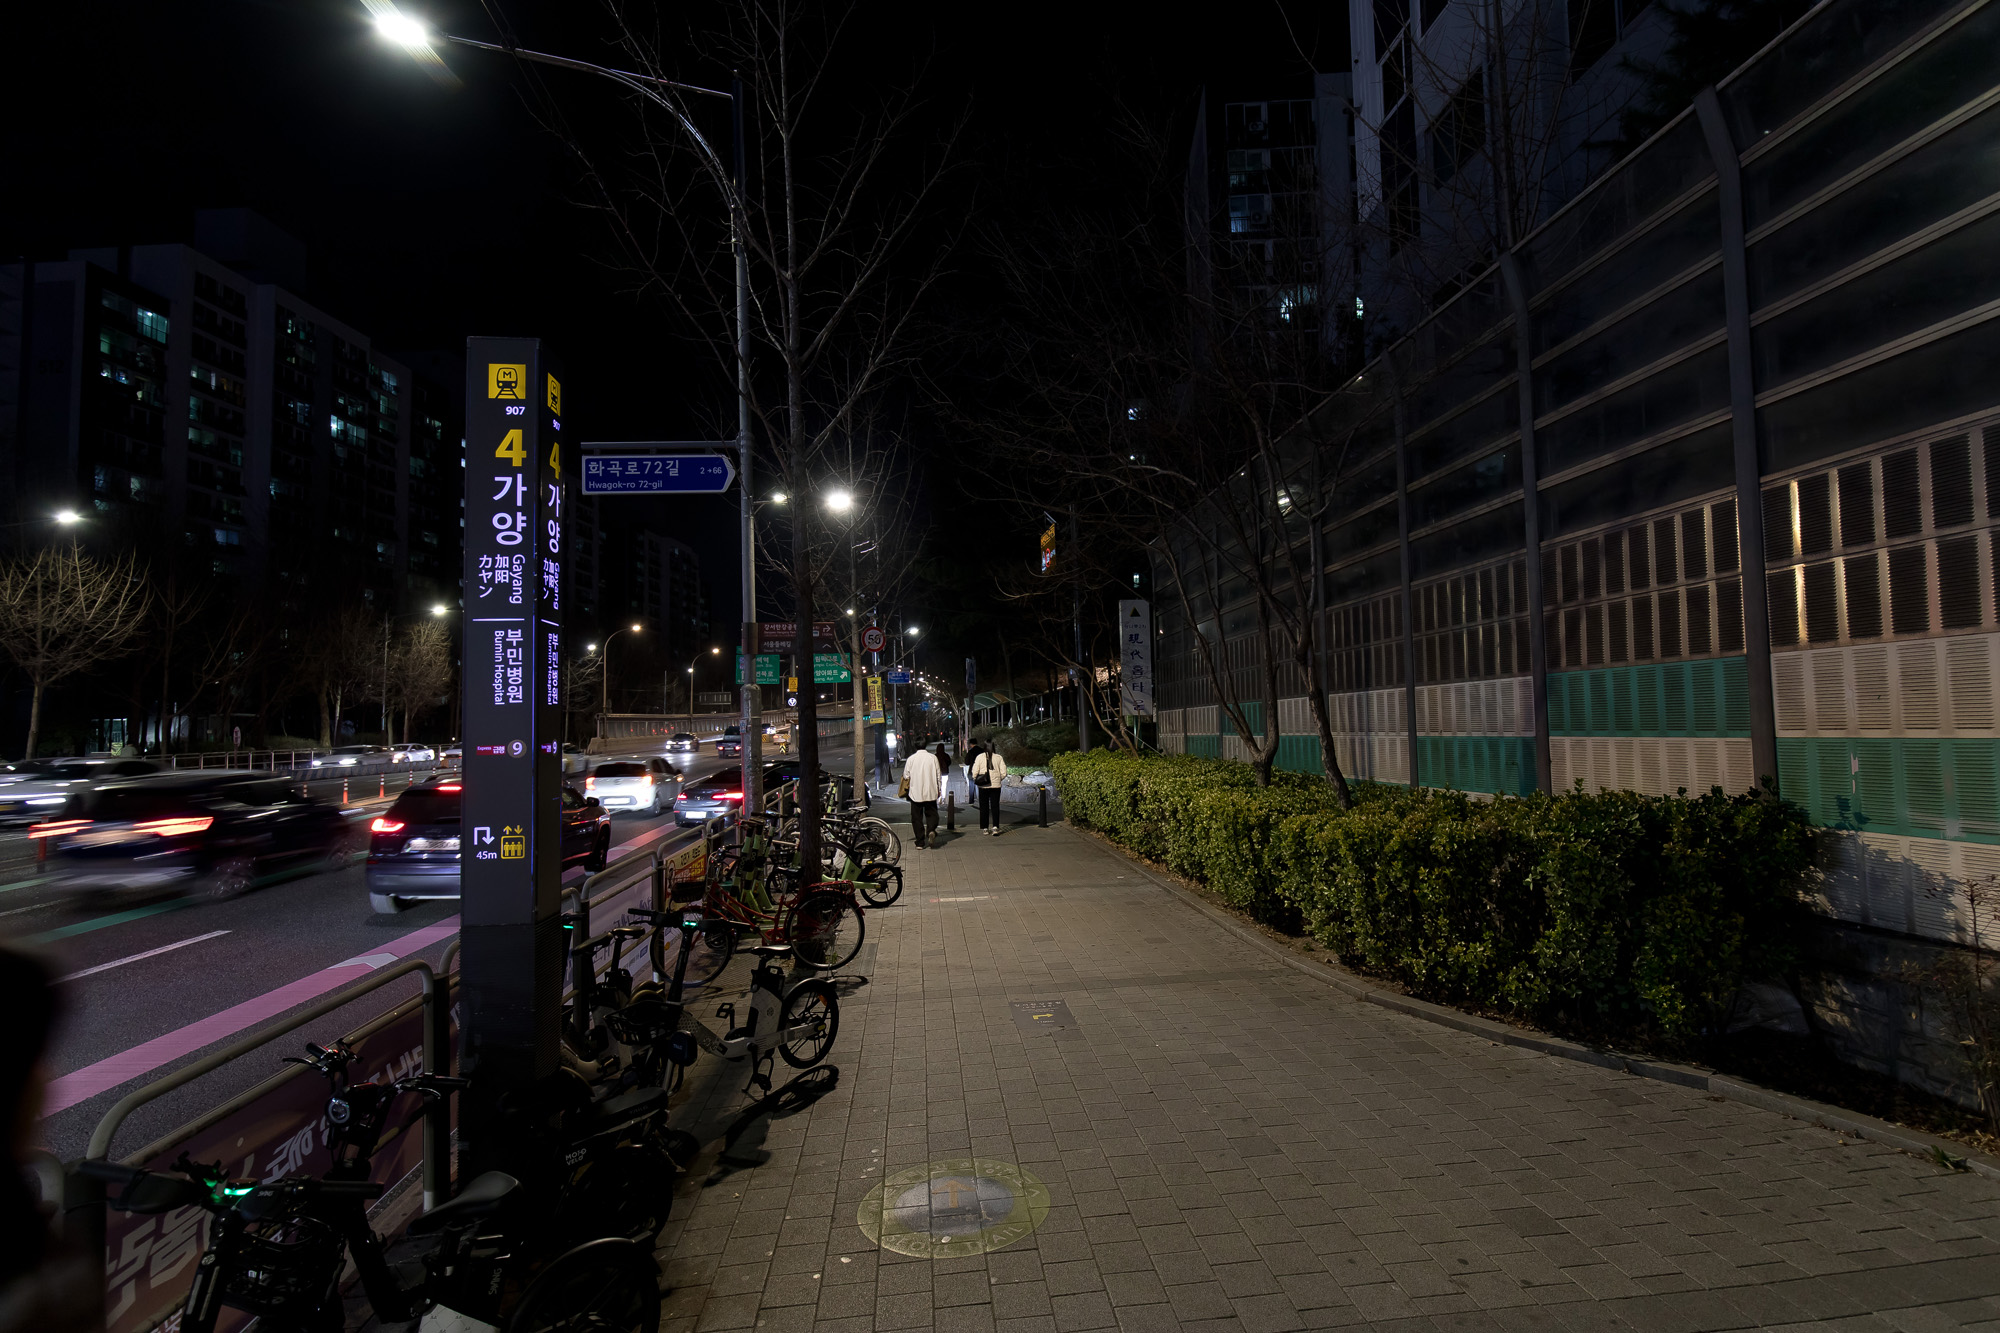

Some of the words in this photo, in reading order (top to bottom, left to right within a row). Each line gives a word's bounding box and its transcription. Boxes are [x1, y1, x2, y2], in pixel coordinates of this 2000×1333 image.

[505, 406, 526, 415] 907
[495, 429, 527, 467] 4
[549, 442, 560, 480] 4
[588, 460, 679, 477] 화곡로72길
[588, 481, 636, 490] Hwagok-ro
[638, 480, 663, 490] 72-gil
[492, 473, 528, 545] 가양
[547, 484, 560, 553] 가양
[478, 555, 493, 598] カヤン
[495, 554, 509, 584] 加阳
[509, 554, 526, 604] Gayang
[494, 630, 505, 662] Bumin
[867, 634, 881, 645] 50
[506, 629, 523, 704] 부민병원
[492, 664, 505, 705] Hospital
[512, 741, 523, 756] 9
[476, 851, 497, 859] 45m
